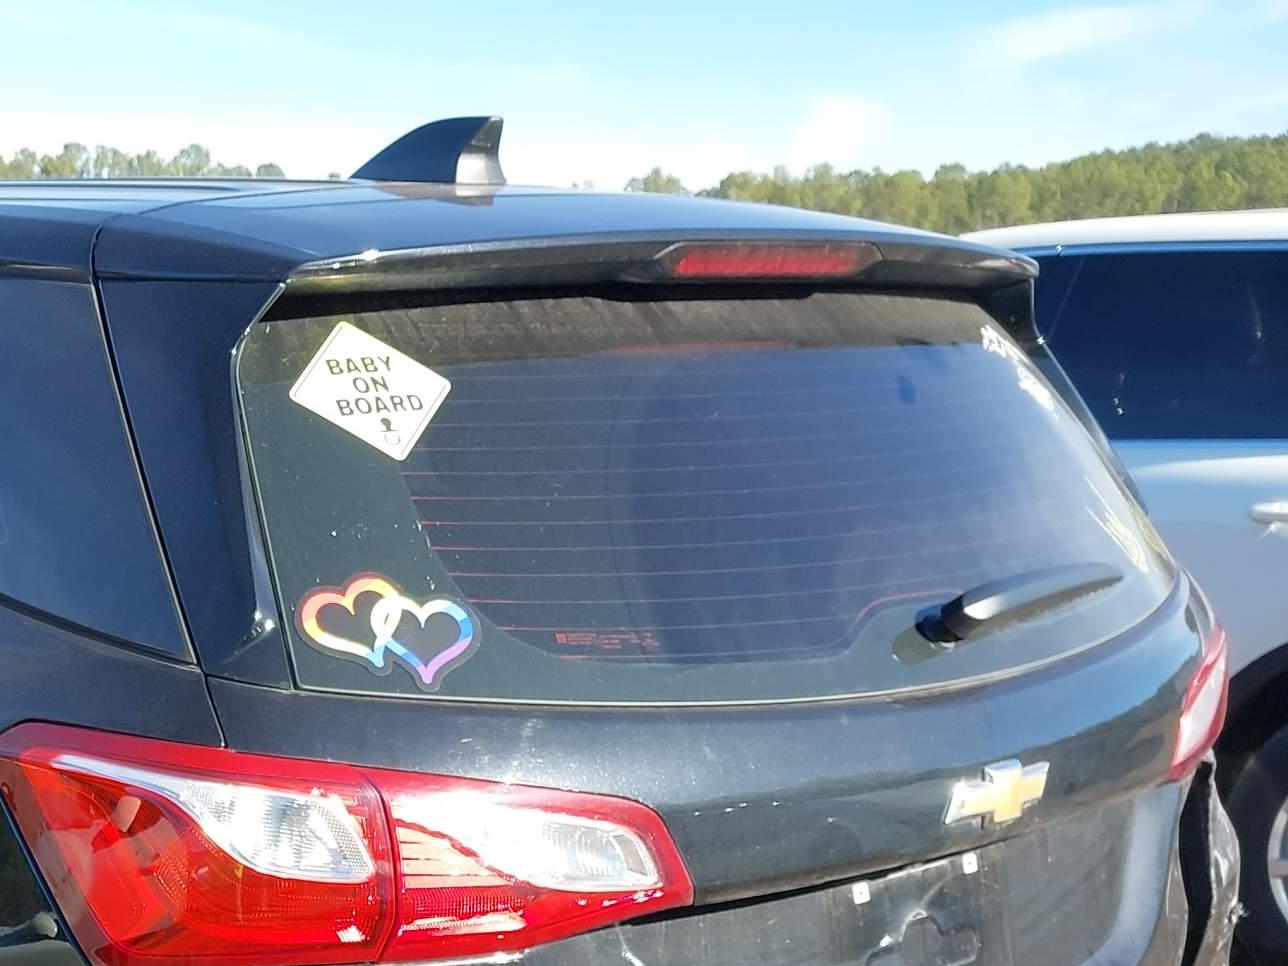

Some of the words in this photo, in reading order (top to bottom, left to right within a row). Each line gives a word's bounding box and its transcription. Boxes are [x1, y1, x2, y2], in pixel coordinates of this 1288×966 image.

[325, 356, 392, 376] BABY
[352, 375, 390, 394] ON
[335, 394, 424, 417] BOARD
